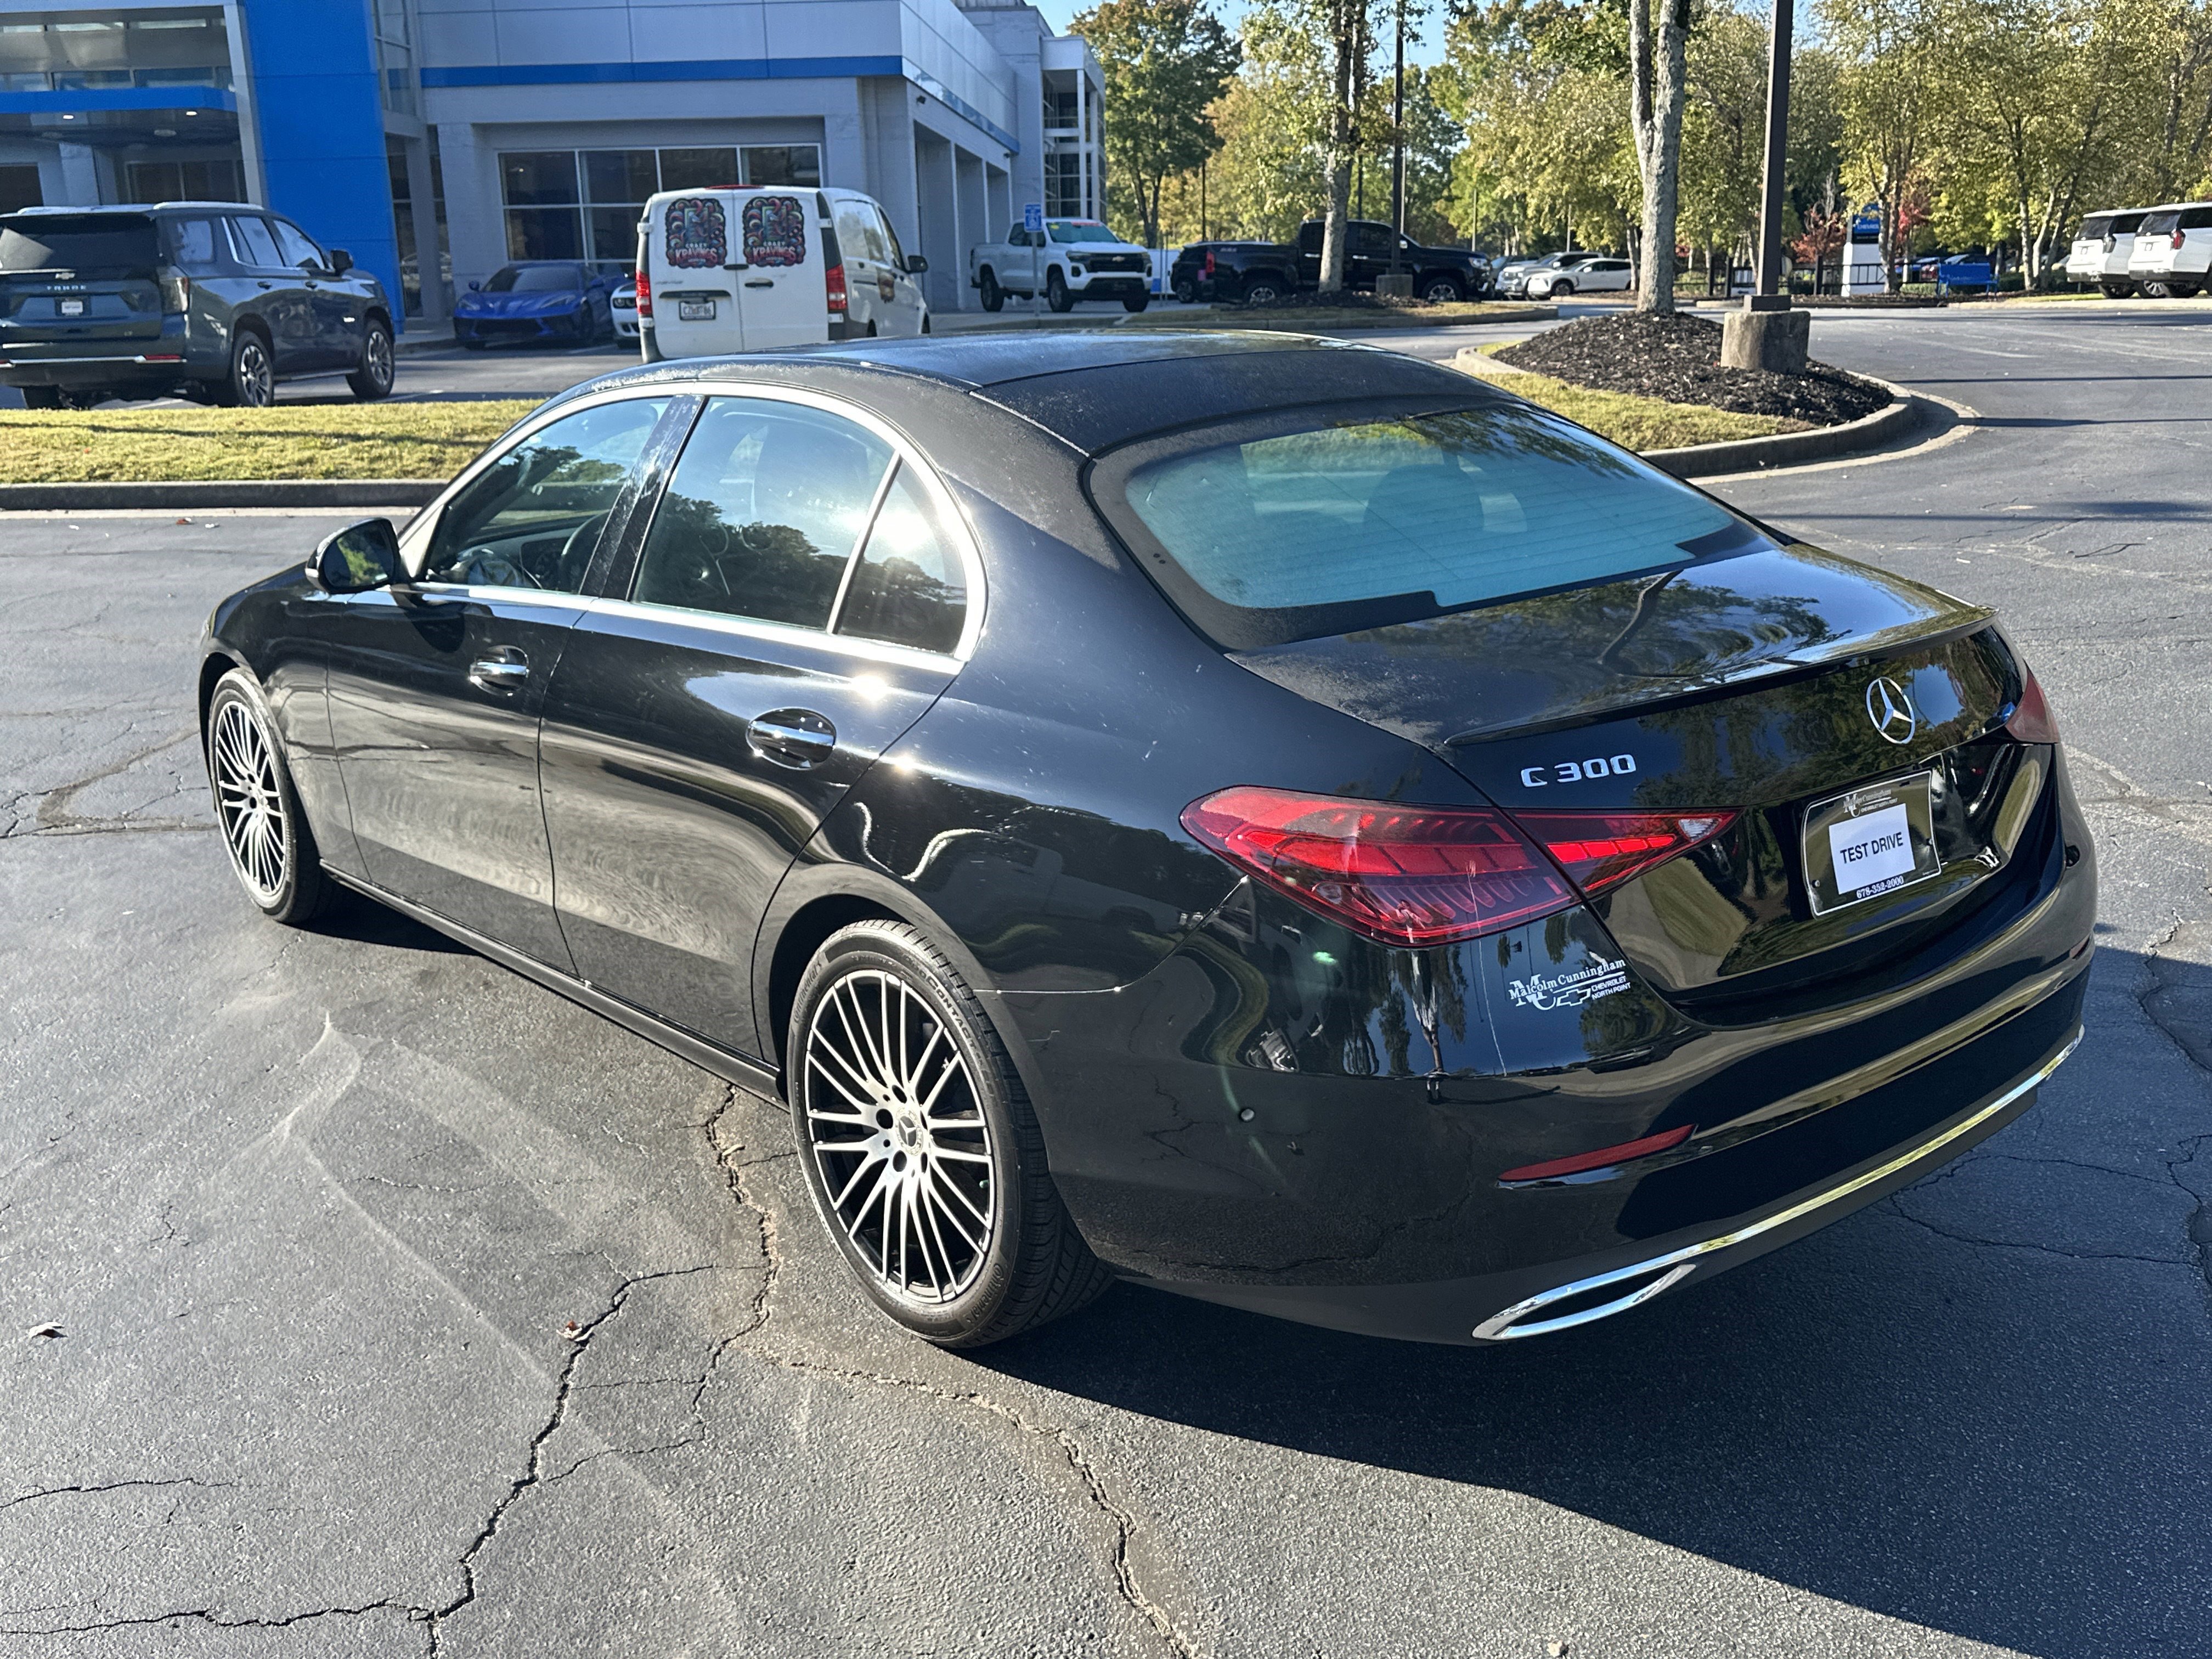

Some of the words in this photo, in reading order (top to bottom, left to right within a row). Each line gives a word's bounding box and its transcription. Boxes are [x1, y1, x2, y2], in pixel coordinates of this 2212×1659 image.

[1521, 767, 1548, 787] C
[1554, 754, 1637, 783] 300
[1840, 843, 1868, 864] TEST
[1871, 832, 1904, 854] DRIVE
[1856, 875, 1904, 899] 678-352-2000
[1509, 979, 1558, 1000] Malcolm
[1558, 960, 1626, 985] Cunningham
[1591, 975, 1627, 992] CHEVROLET
[1592, 988, 1613, 1000] NORTH
[1613, 982, 1631, 994] POINT
